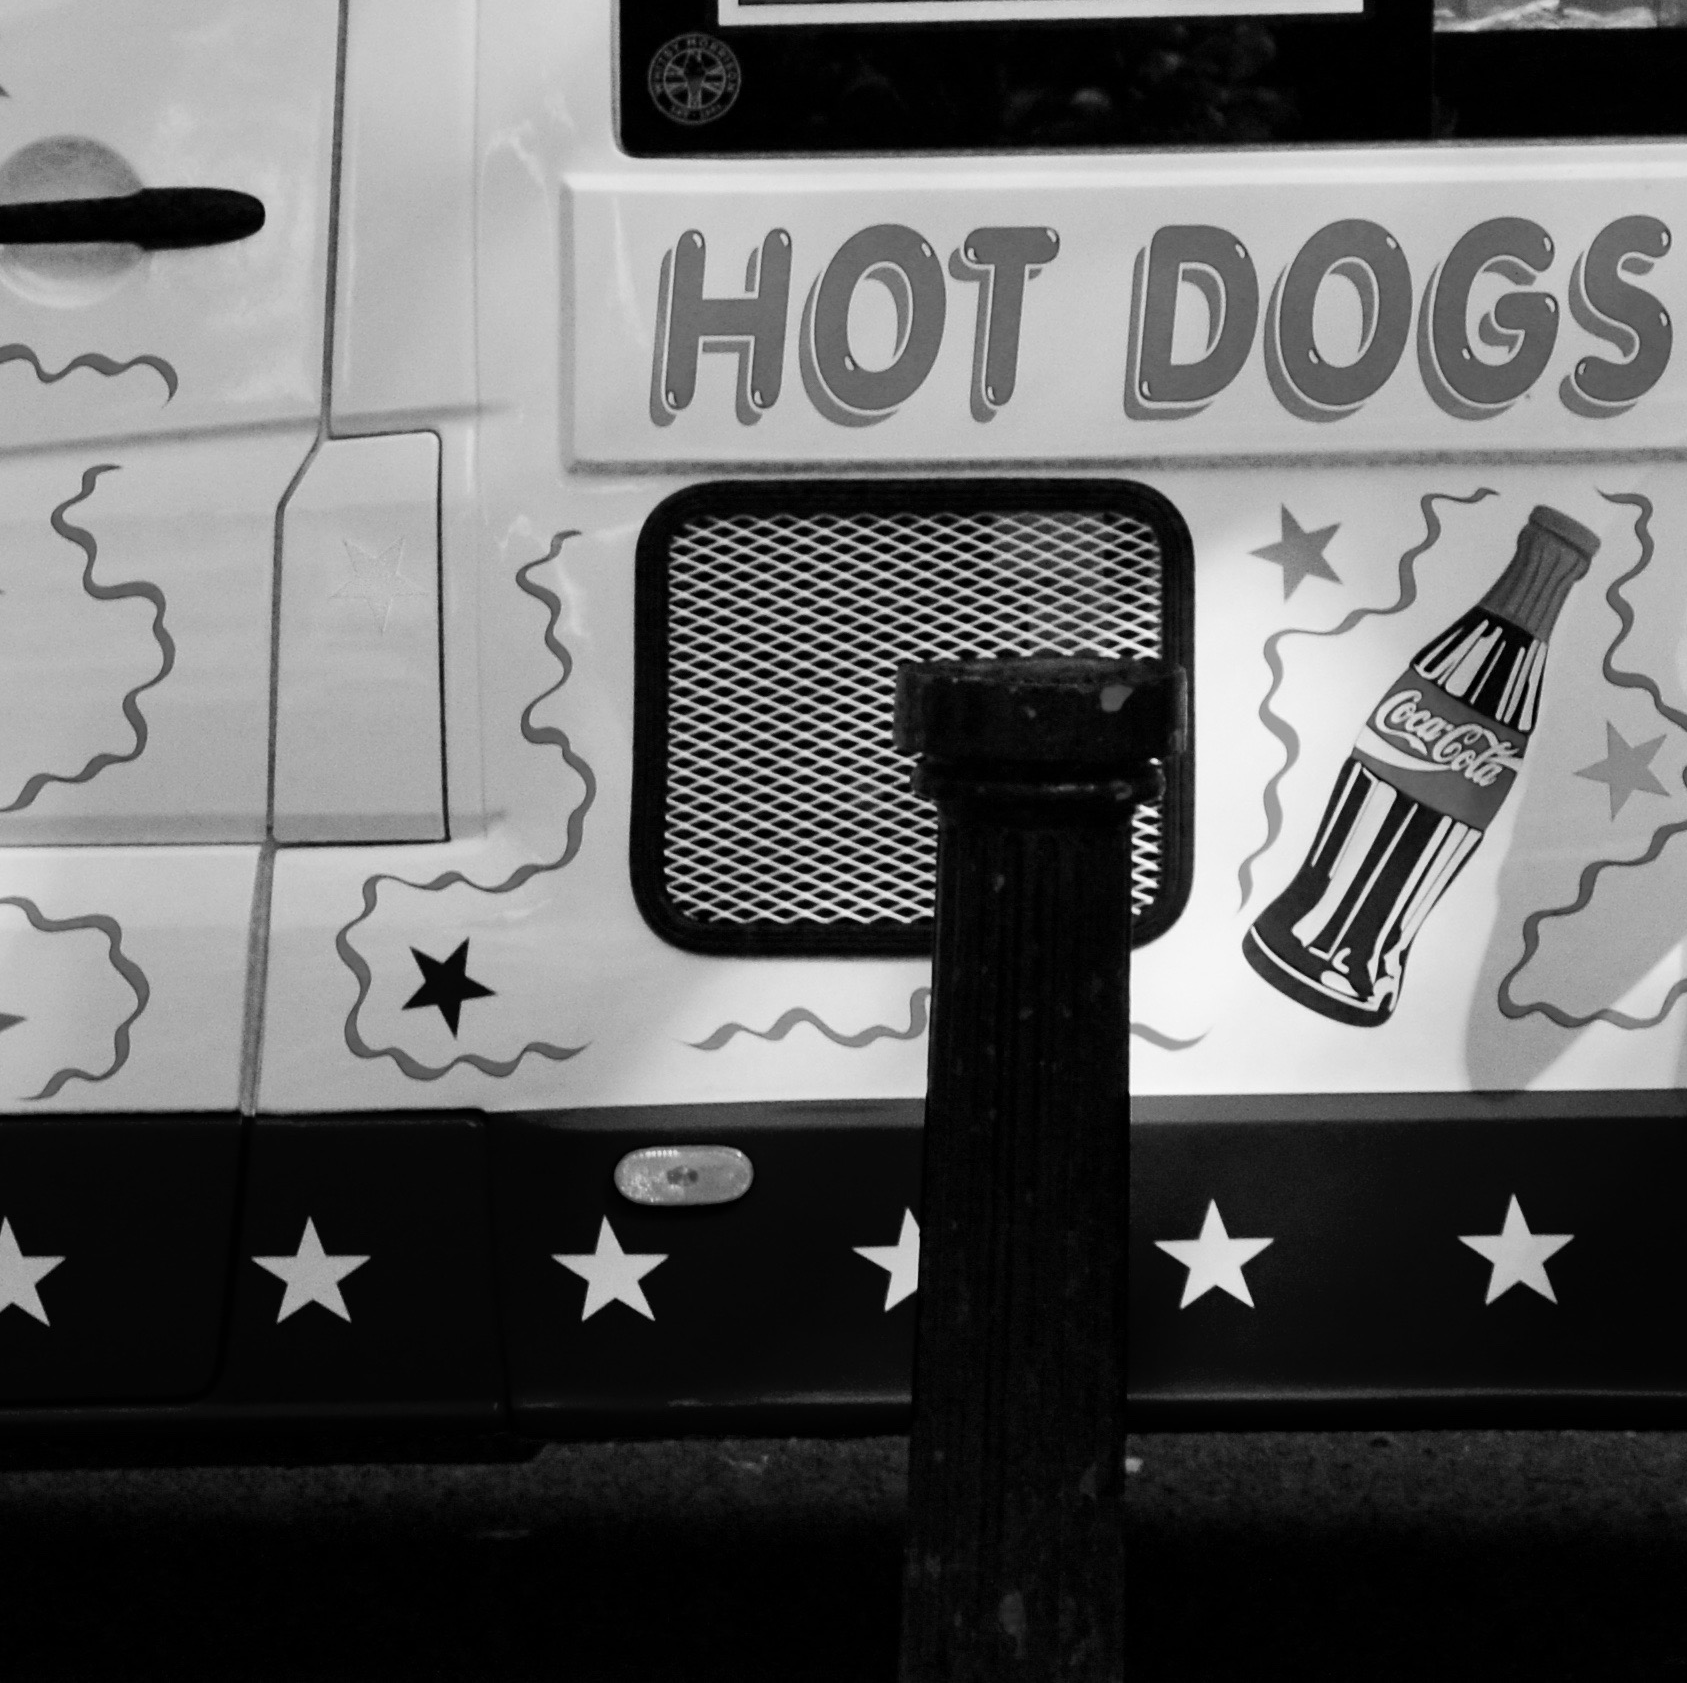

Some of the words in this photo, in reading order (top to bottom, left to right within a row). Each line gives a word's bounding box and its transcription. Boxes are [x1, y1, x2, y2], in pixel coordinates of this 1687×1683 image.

[649, 221, 1061, 427] HOT
[1123, 212, 1675, 424] DOGS
[1374, 688, 1525, 788] Coca-Cola
